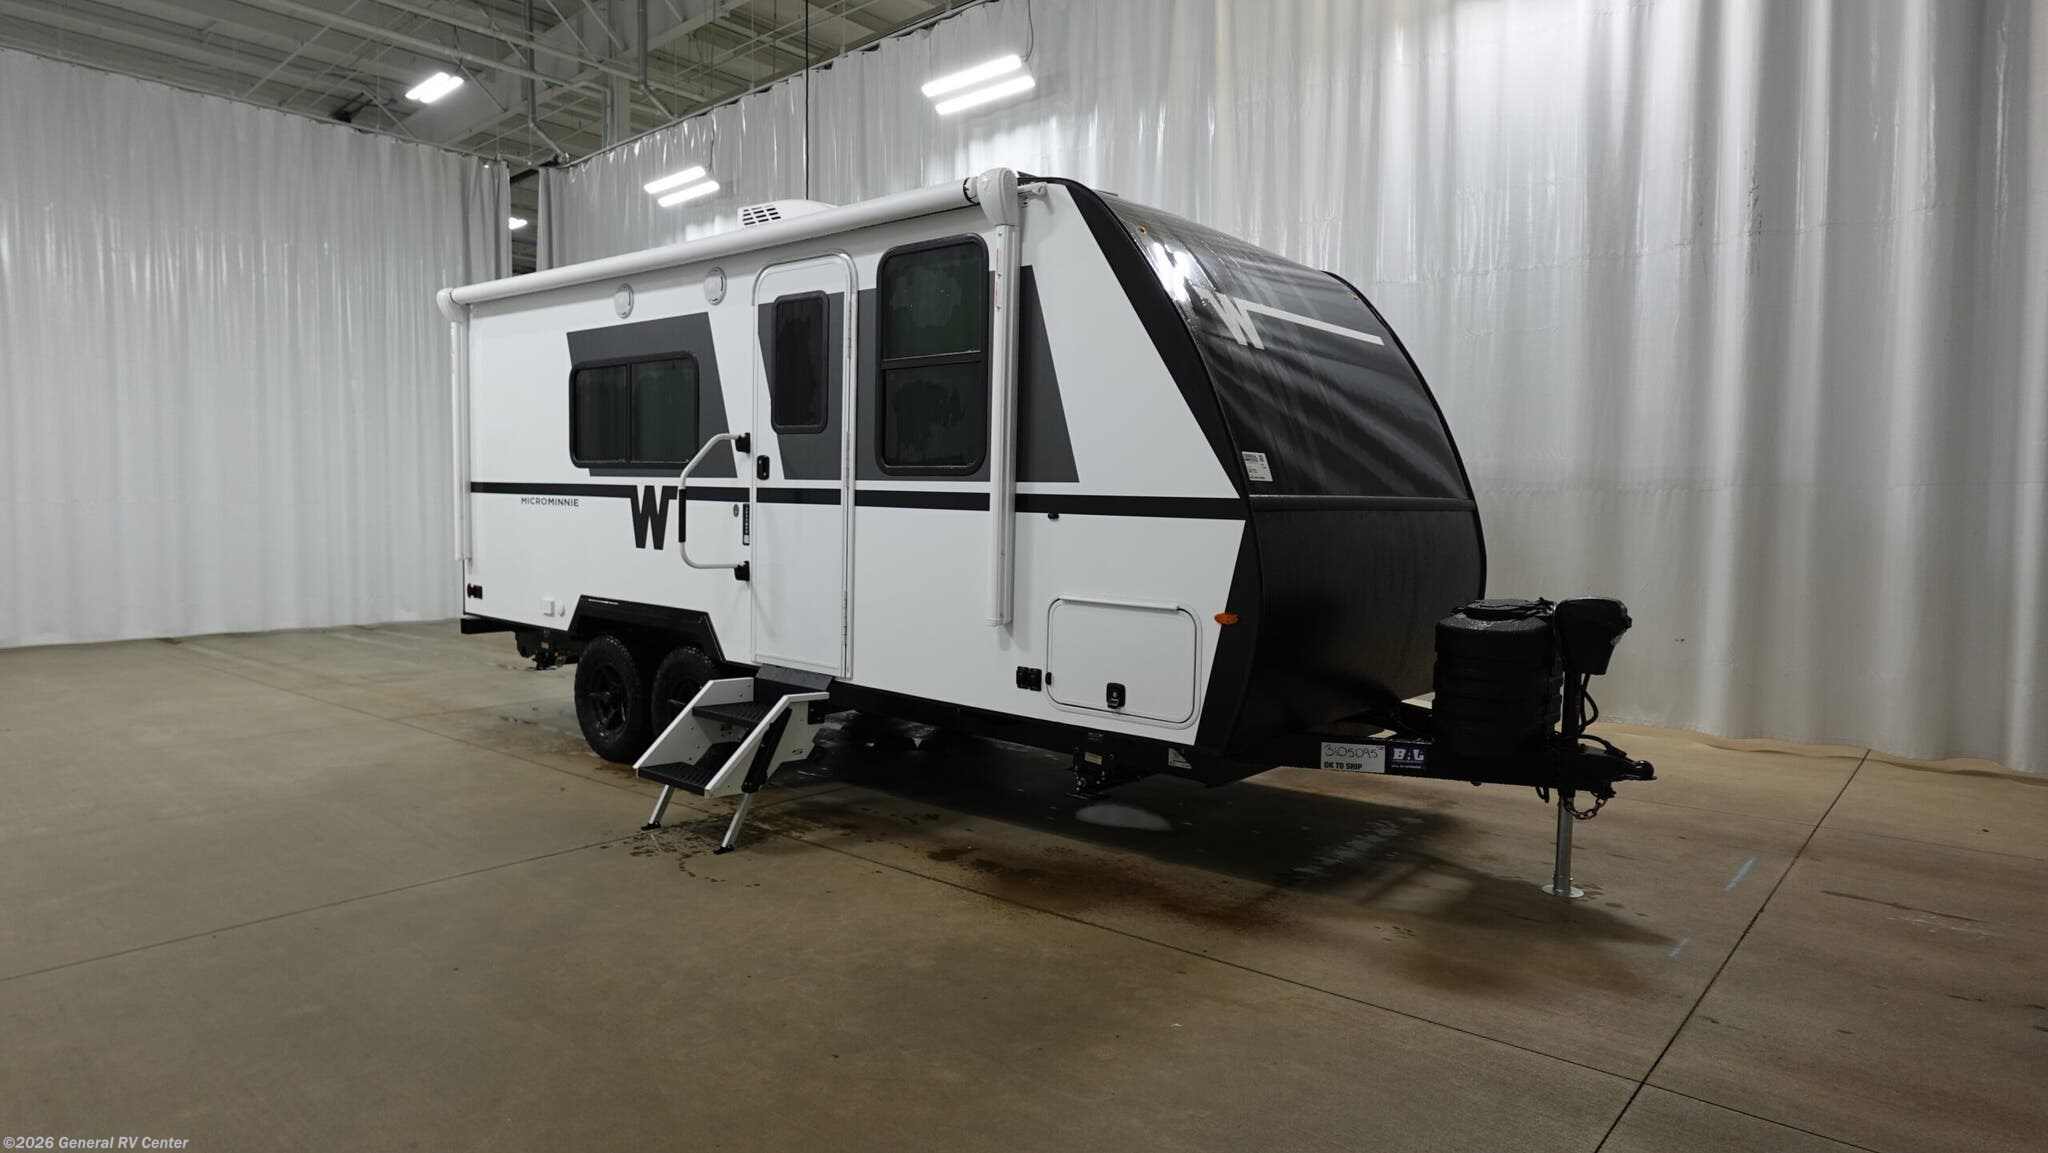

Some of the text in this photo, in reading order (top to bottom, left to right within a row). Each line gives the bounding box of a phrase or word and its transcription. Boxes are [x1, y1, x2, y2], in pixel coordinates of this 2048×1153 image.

[520, 497, 579, 507] MICROMINNIE
[630, 485, 679, 550] W
[1324, 761, 1334, 769] OK
